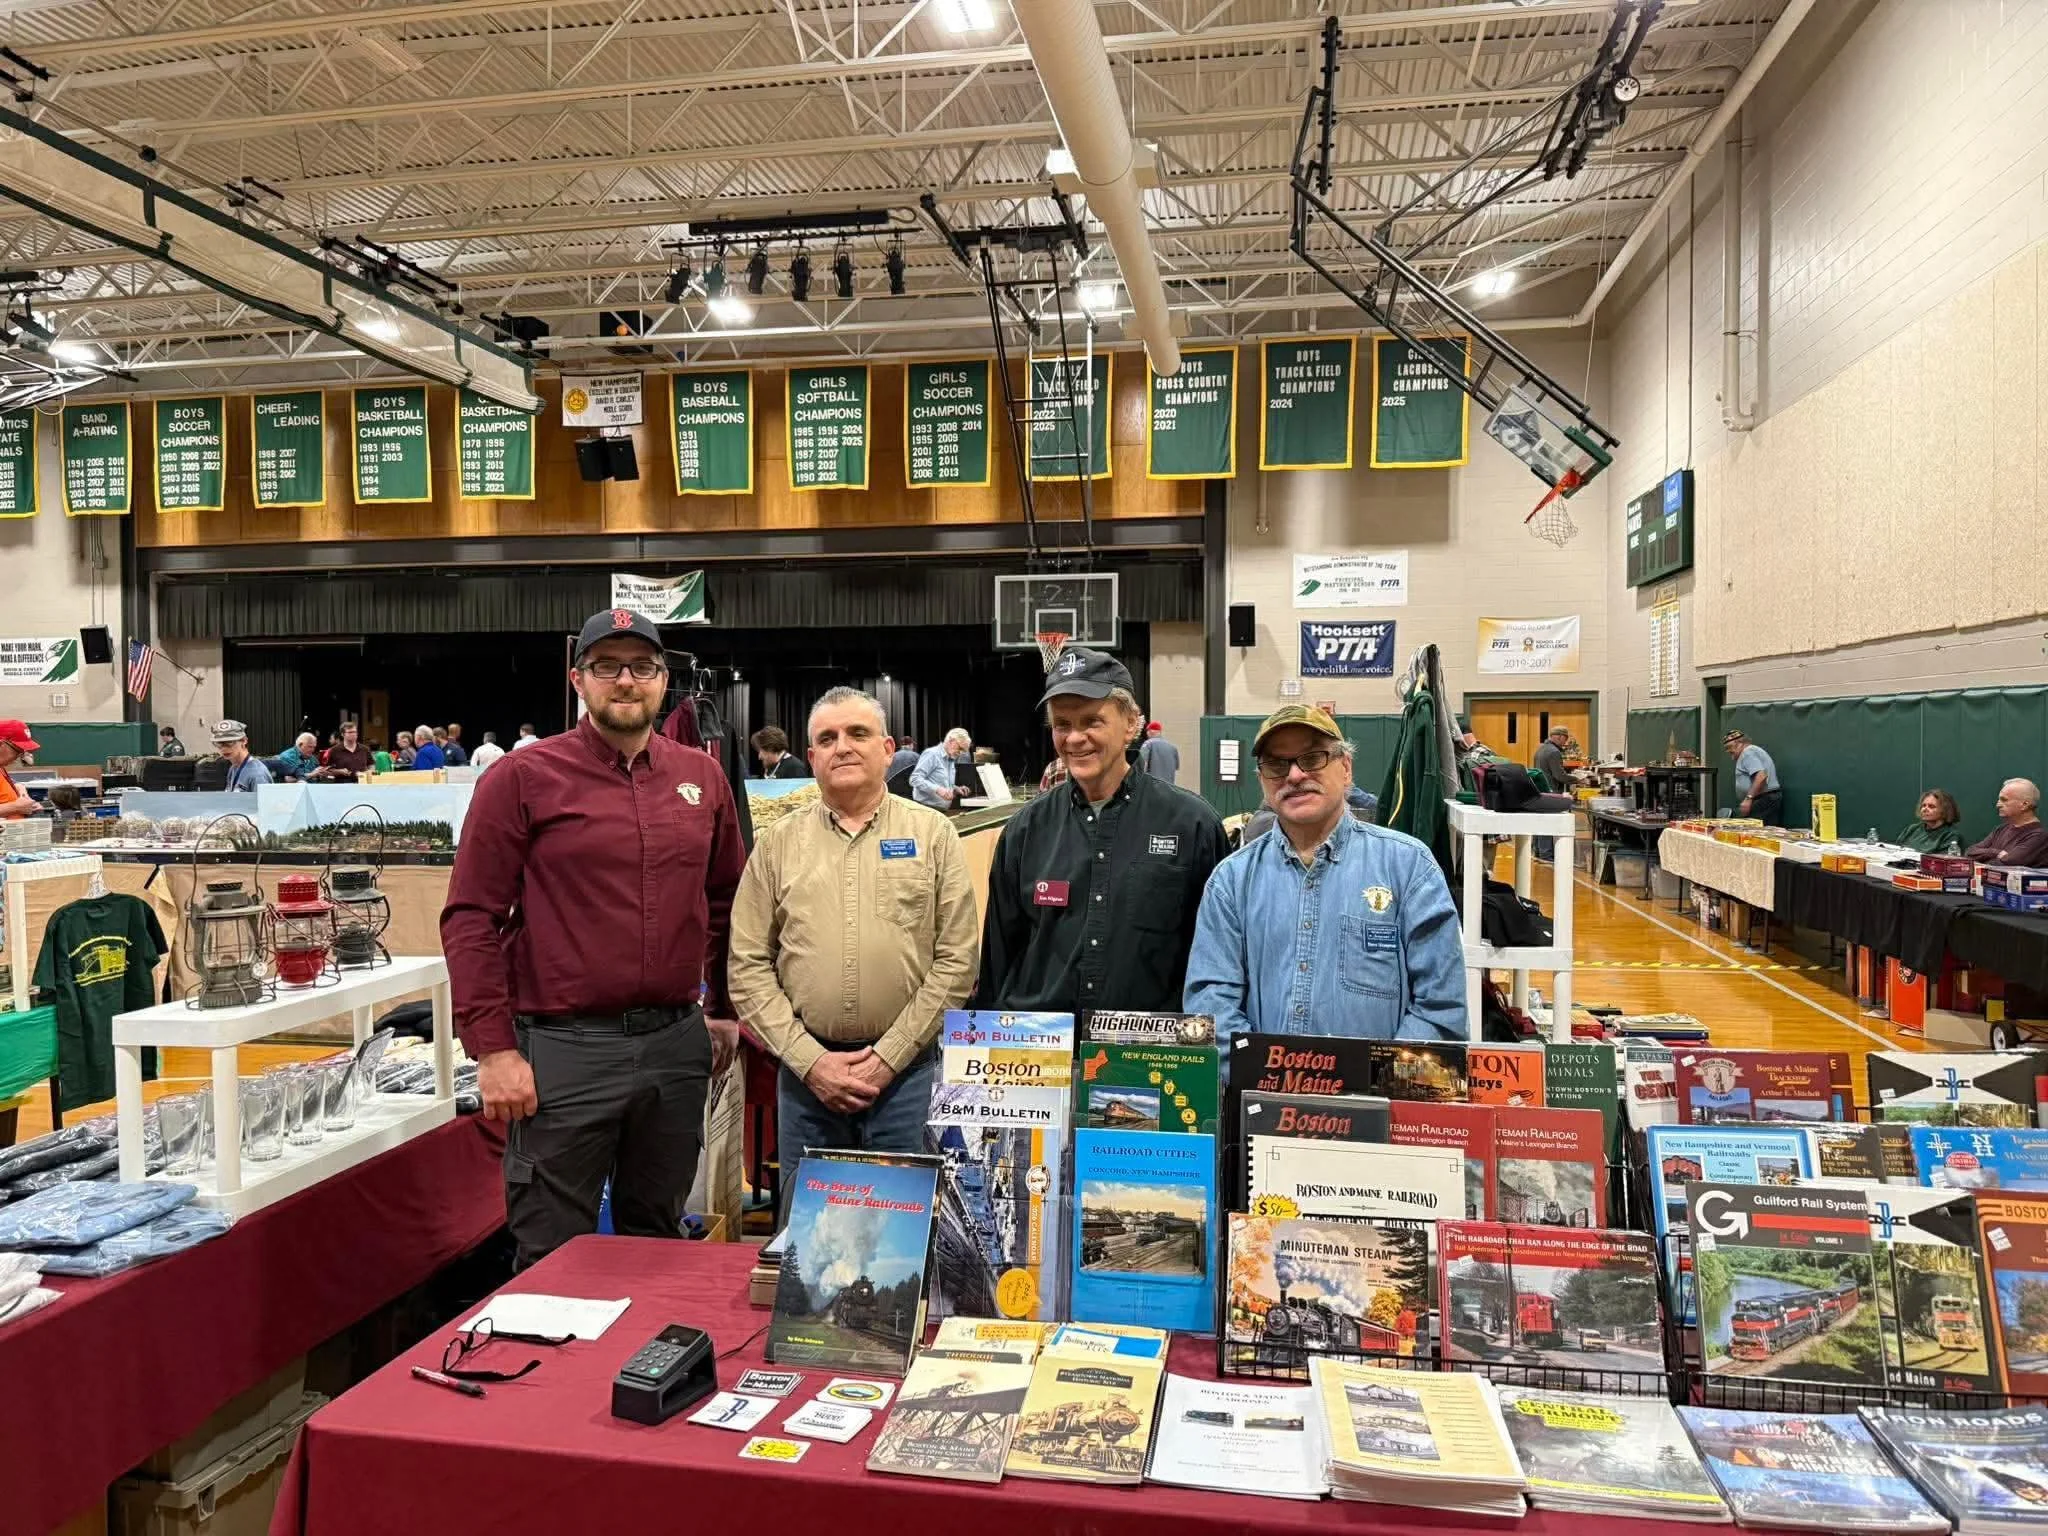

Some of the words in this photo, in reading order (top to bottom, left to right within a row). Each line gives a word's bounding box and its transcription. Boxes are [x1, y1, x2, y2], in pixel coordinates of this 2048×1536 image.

[1296, 350, 1321, 363] BOYS
[1180, 361, 1203, 374] BOYS
[1275, 366, 1304, 379] TRACK
[1306, 366, 1313, 377] &
[1315, 364, 1342, 377] FIELD
[809, 376, 847, 389] GIRLS
[929, 372, 967, 384] GIRLS
[1156, 377, 1184, 390] CROSS
[1188, 375, 1227, 388] COUNTRY
[693, 383, 728, 393] BOYS
[1280, 380, 1335, 394] CHAMPIONS
[1393, 378, 1449, 392] CHAMPIONS
[797, 391, 860, 404] SOFTBALL
[923, 387, 973, 400] SOCCER
[1165, 391, 1218, 405] CHAMPIONS
[374, 397, 406, 409] BOYS
[682, 396, 740, 408] BASEBALL
[1270, 399, 1293, 408] 2024
[1382, 397, 1406, 406] 2025
[174, 408, 205, 419] BOYS
[358, 410, 423, 422] BASKETBALL
[794, 408, 862, 422] CHAMPIONS
[913, 404, 983, 418] CHAMPIONS
[1033, 410, 1055, 420] 2022
[1154, 409, 1177, 418] 2020
[81, 413, 108, 425] BAND
[273, 415, 320, 427] LEADING
[679, 412, 745, 425] CHAMPIONS
[73, 425, 118, 437] A-RATING
[168, 420, 211, 433] SOCCER
[463, 421, 527, 433] CHAMPIONS
[818, 426, 838, 435] 1996
[842, 425, 862, 434] 2024
[962, 421, 982, 431] 2014
[1033, 422, 1055, 431] 2025
[1154, 420, 1176, 430] 2021
[360, 425, 423, 438] CHAMPIONS
[161, 436, 220, 448] CHAMPIONS
[912, 447, 932, 456] 2001
[938, 445, 958, 454] 2010
[938, 456, 958, 465] 2011
[938, 468, 959, 477] 2013
[1380, 579, 1400, 587] PTA
[610, 609, 634, 630] B
[1311, 624, 1385, 637] Hooksett
[1315, 638, 1378, 661] PTA
[1492, 641, 1510, 649] PTA
[1090, 1016, 1177, 1033] HIGHLINER
[952, 1031, 986, 1042] B&M
[991, 1032, 1061, 1043] BULLETIN
[1142, 1053, 1180, 1061] ENGLAND
[1181, 1055, 1205, 1063] RAILS
[1265, 1045, 1337, 1071] Boston
[1551, 1054, 1600, 1065] DEPOTS
[966, 1060, 1041, 1076] Boston
[1756, 1064, 1783, 1073] Boston
[1793, 1064, 1819, 1073] Maine
[1256, 1073, 1280, 1092] and
[1280, 1070, 1345, 1095] Maine
[941, 1104, 974, 1115] B&M
[980, 1107, 1051, 1120] BULLETIN
[1275, 1106, 1352, 1135] Boston
[1421, 1124, 1469, 1137] RAILROAD
[1530, 1128, 1578, 1140] RAILROAD
[1392, 1135, 1415, 1143] Maine's
[1417, 1137, 1446, 1145] Lexington
[1501, 1139, 1524, 1147] Maine's
[1526, 1141, 1555, 1149] Lexington
[1556, 1142, 1578, 1150] Branch
[1665, 1140, 1683, 1149] New
[1684, 1140, 1731, 1151] Hampshire
[1733, 1142, 1751, 1150] and
[1753, 1143, 1790, 1152] Vermont
[1092, 1146, 1152, 1157] RAILROAD
[1156, 1150, 1197, 1160] CITIES
[1707, 1149, 1751, 1159] Railroads
[807, 1179, 828, 1190] The
[831, 1181, 857, 1193] Best
[859, 1184, 875, 1196] of
[1296, 1184, 1337, 1198] BOSTON
[1338, 1187, 1356, 1197] AND
[1356, 1188, 1383, 1199] MAINE
[1388, 1191, 1437, 1209] RAILROAD
[826, 1195, 862, 1206] Maine
[864, 1198, 924, 1213] Railroads
[1754, 1196, 1798, 1209] Guilford
[1801, 1198, 1823, 1209] Rail
[1826, 1200, 1867, 1212] System
[1468, 1235, 1506, 1245] RAILROADS
[1508, 1237, 1525, 1245] THAT
[1527, 1239, 1541, 1247] RAN
[1543, 1239, 1566, 1248] ALONG
[1567, 1241, 1580, 1249] THE
[1581, 1241, 1597, 1250] EDGE
[1599, 1243, 1610, 1251] OF
[1612, 1244, 1626, 1252] THE
[1627, 1245, 1648, 1253] ROAD
[1815, 1236, 1838, 1244] VOLUME
[1280, 1239, 1349, 1257] MINUTEMAN
[1354, 1248, 1393, 1262] STEAM
[749, 1373, 791, 1382] BOSTON
[1906, 1374, 1935, 1386] Maine
[1517, 1400, 1610, 1415] CENTRAL
[1519, 1407, 1621, 1422] VERMONT
[1953, 1412, 2042, 1428] ROADS
